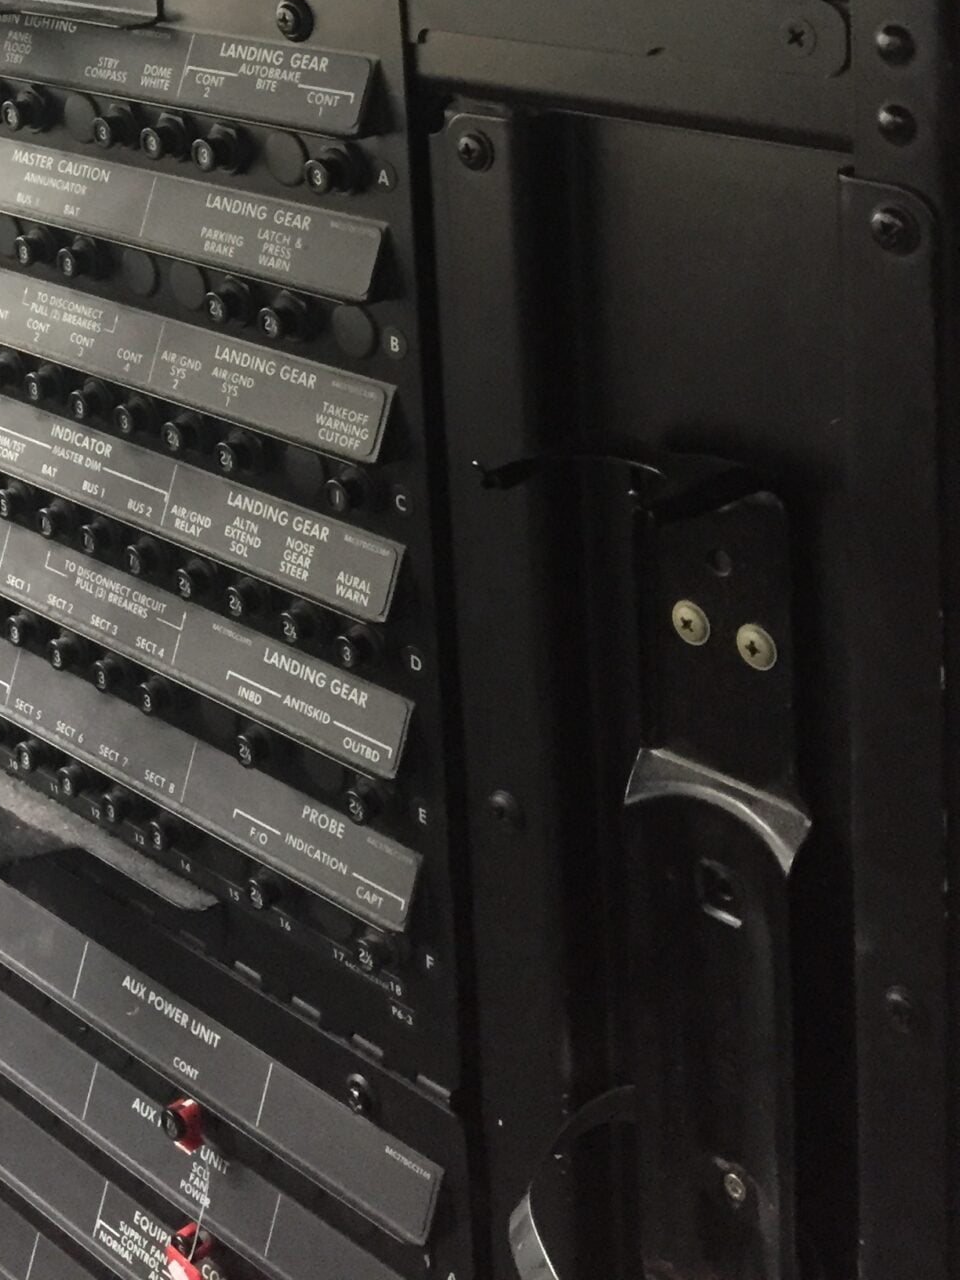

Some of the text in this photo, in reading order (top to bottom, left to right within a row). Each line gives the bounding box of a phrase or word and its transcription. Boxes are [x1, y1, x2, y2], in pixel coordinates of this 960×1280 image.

[24, 15, 77, 33] LIGHTING
[219, 42, 329, 72] LANDING GEAR
[143, 64, 173, 79] DOME
[195, 72, 225, 87] CONT
[239, 62, 302, 83] AUTOBRAKE
[140, 77, 171, 91] WHITE
[256, 77, 278, 92] BITE
[307, 91, 340, 107] CONT
[12, 149, 111, 183] MASTER CAUTION
[377, 170, 390, 186] A
[205, 193, 312, 231] LANDING GEAR
[200, 226, 244, 248] PARKING
[257, 227, 291, 246] LATCH
[203, 240, 235, 258] BRAKE
[261, 242, 291, 260] PRESS
[257, 254, 291, 272] WARN
[37, 291, 104, 320] TO DISCONNECT
[116, 348, 143, 363] CONT
[390, 336, 400, 352] B
[161, 350, 202, 371] AIR/GND
[214, 344, 317, 389] LANDING GEAR
[211, 366, 255, 389] AIR/GND
[322, 401, 369, 425] TAKEOFF
[315, 413, 369, 440] WARNING
[50, 423, 113, 458] INDICATOR
[318, 427, 361, 451] CUTOFF
[51, 445, 102, 472] MASTER DIM
[395, 494, 407, 512] C
[170, 505, 212, 528] AIR/GND
[174, 518, 204, 538] RELAY
[227, 491, 330, 542] LANDING GEAR
[233, 516, 259, 534] ALTN
[224, 526, 261, 548] EXTEND
[286, 537, 315, 557] NOSE
[229, 541, 249, 558] SOL
[283, 550, 312, 569] GEAR
[279, 562, 309, 582] STEER
[336, 571, 371, 594] AURAL
[64, 559, 167, 614] TO DISCONNECT CIRCUIT
[75, 577, 94, 593] PULL
[108, 593, 148, 619] BREAKERS
[335, 584, 369, 607] WARN
[410, 654, 423, 671] D
[263, 648, 368, 709] LANDING GEAR
[237, 686, 262, 705] INBD
[283, 695, 330, 725] ANTISKID
[343, 737, 380, 763] OUTBD
[301, 805, 345, 839] PROBE
[418, 807, 427, 825] E
[285, 833, 348, 875] INDICATION
[355, 885, 383, 908] CAPT
[389, 981, 402, 996] 18
[121, 975, 221, 1049] AUX POWER UNIT
[173, 1056, 199, 1081] CONT
[131, 1098, 155, 1122] AUX
[199, 1145, 231, 1175] UNIT
[180, 1179, 211, 1208] POWER
[98, 1231, 134, 1265] NORMAL
[118, 1220, 169, 1266] SUPPLY FAN
[120, 1235, 160, 1273] CONTROL
